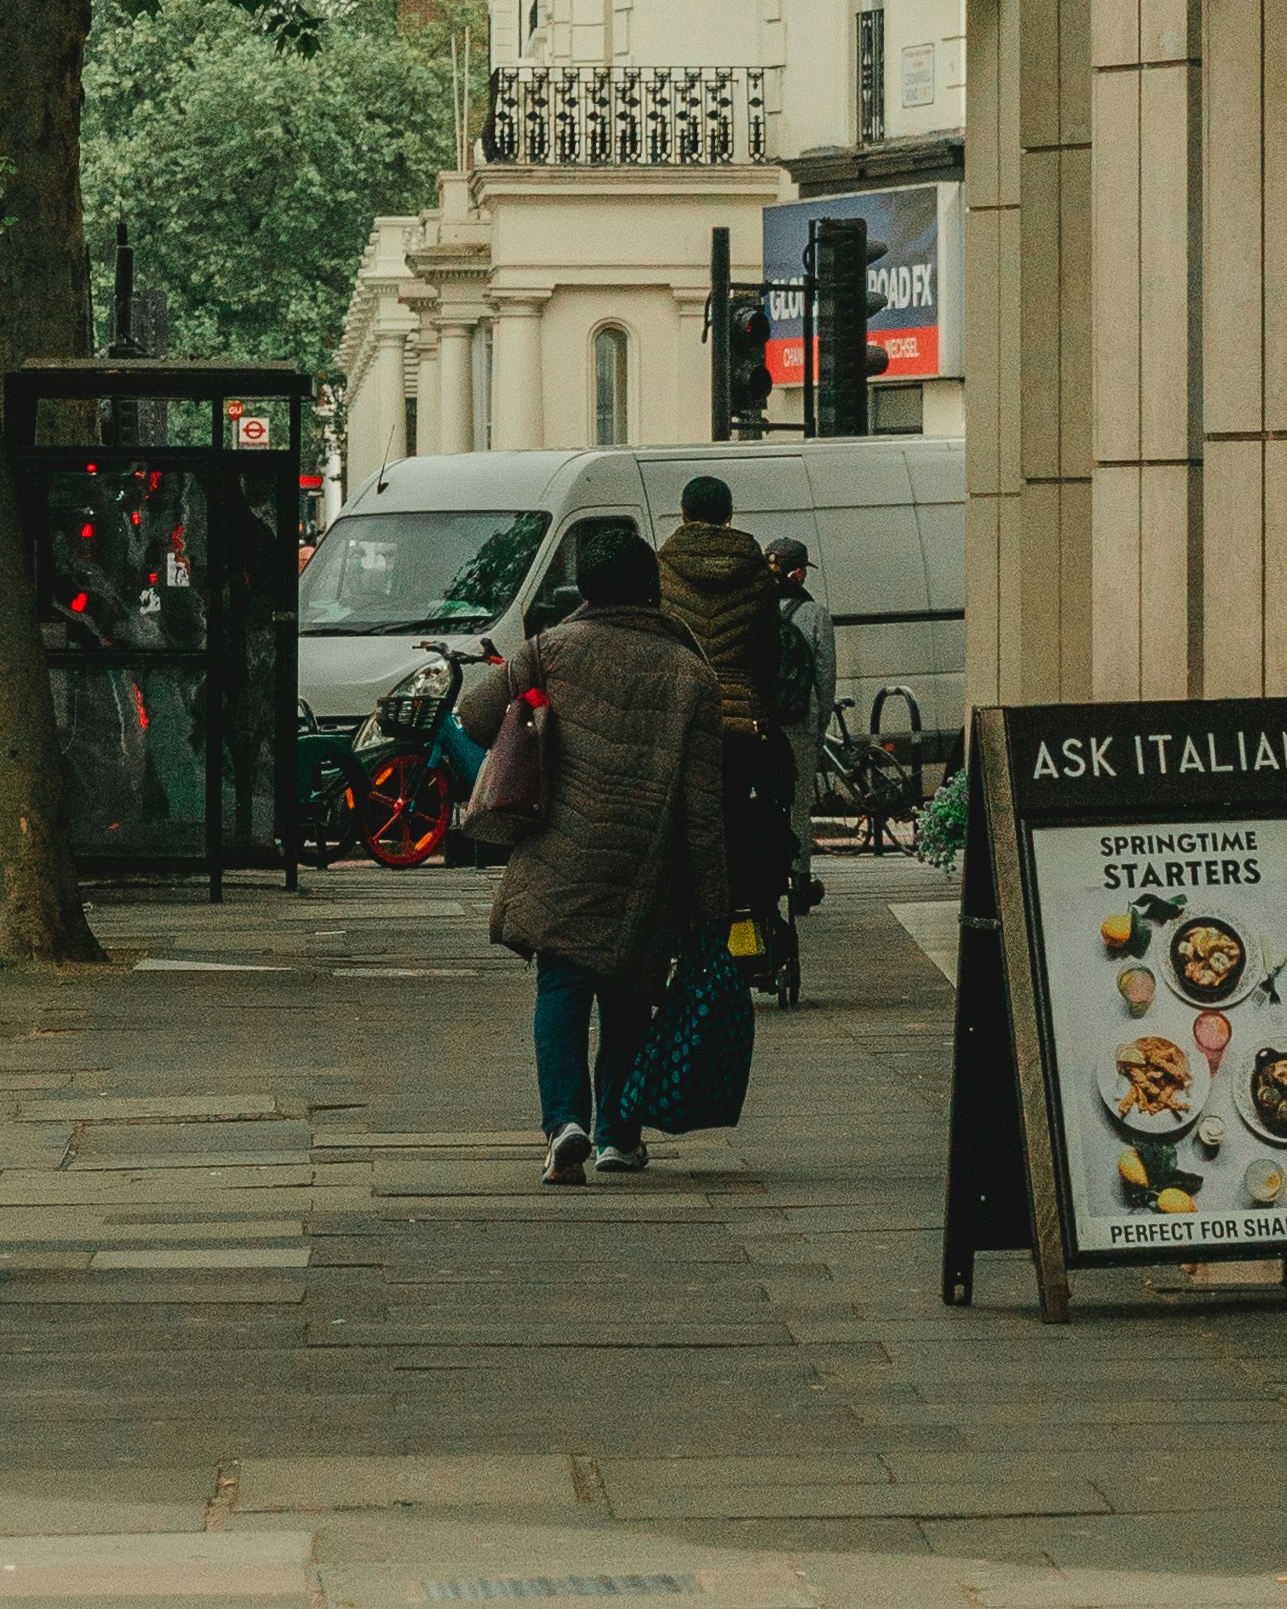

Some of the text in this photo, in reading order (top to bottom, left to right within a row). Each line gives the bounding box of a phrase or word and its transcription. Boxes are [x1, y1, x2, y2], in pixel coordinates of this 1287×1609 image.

[912, 263, 933, 307] FX
[1033, 736, 1117, 779] ASK
[1100, 831, 1258, 857] SPRINGTIME
[1103, 858, 1262, 890] STARTERS
[1110, 1221, 1194, 1244] PERFECT
[1201, 1220, 1239, 1240] FOR
